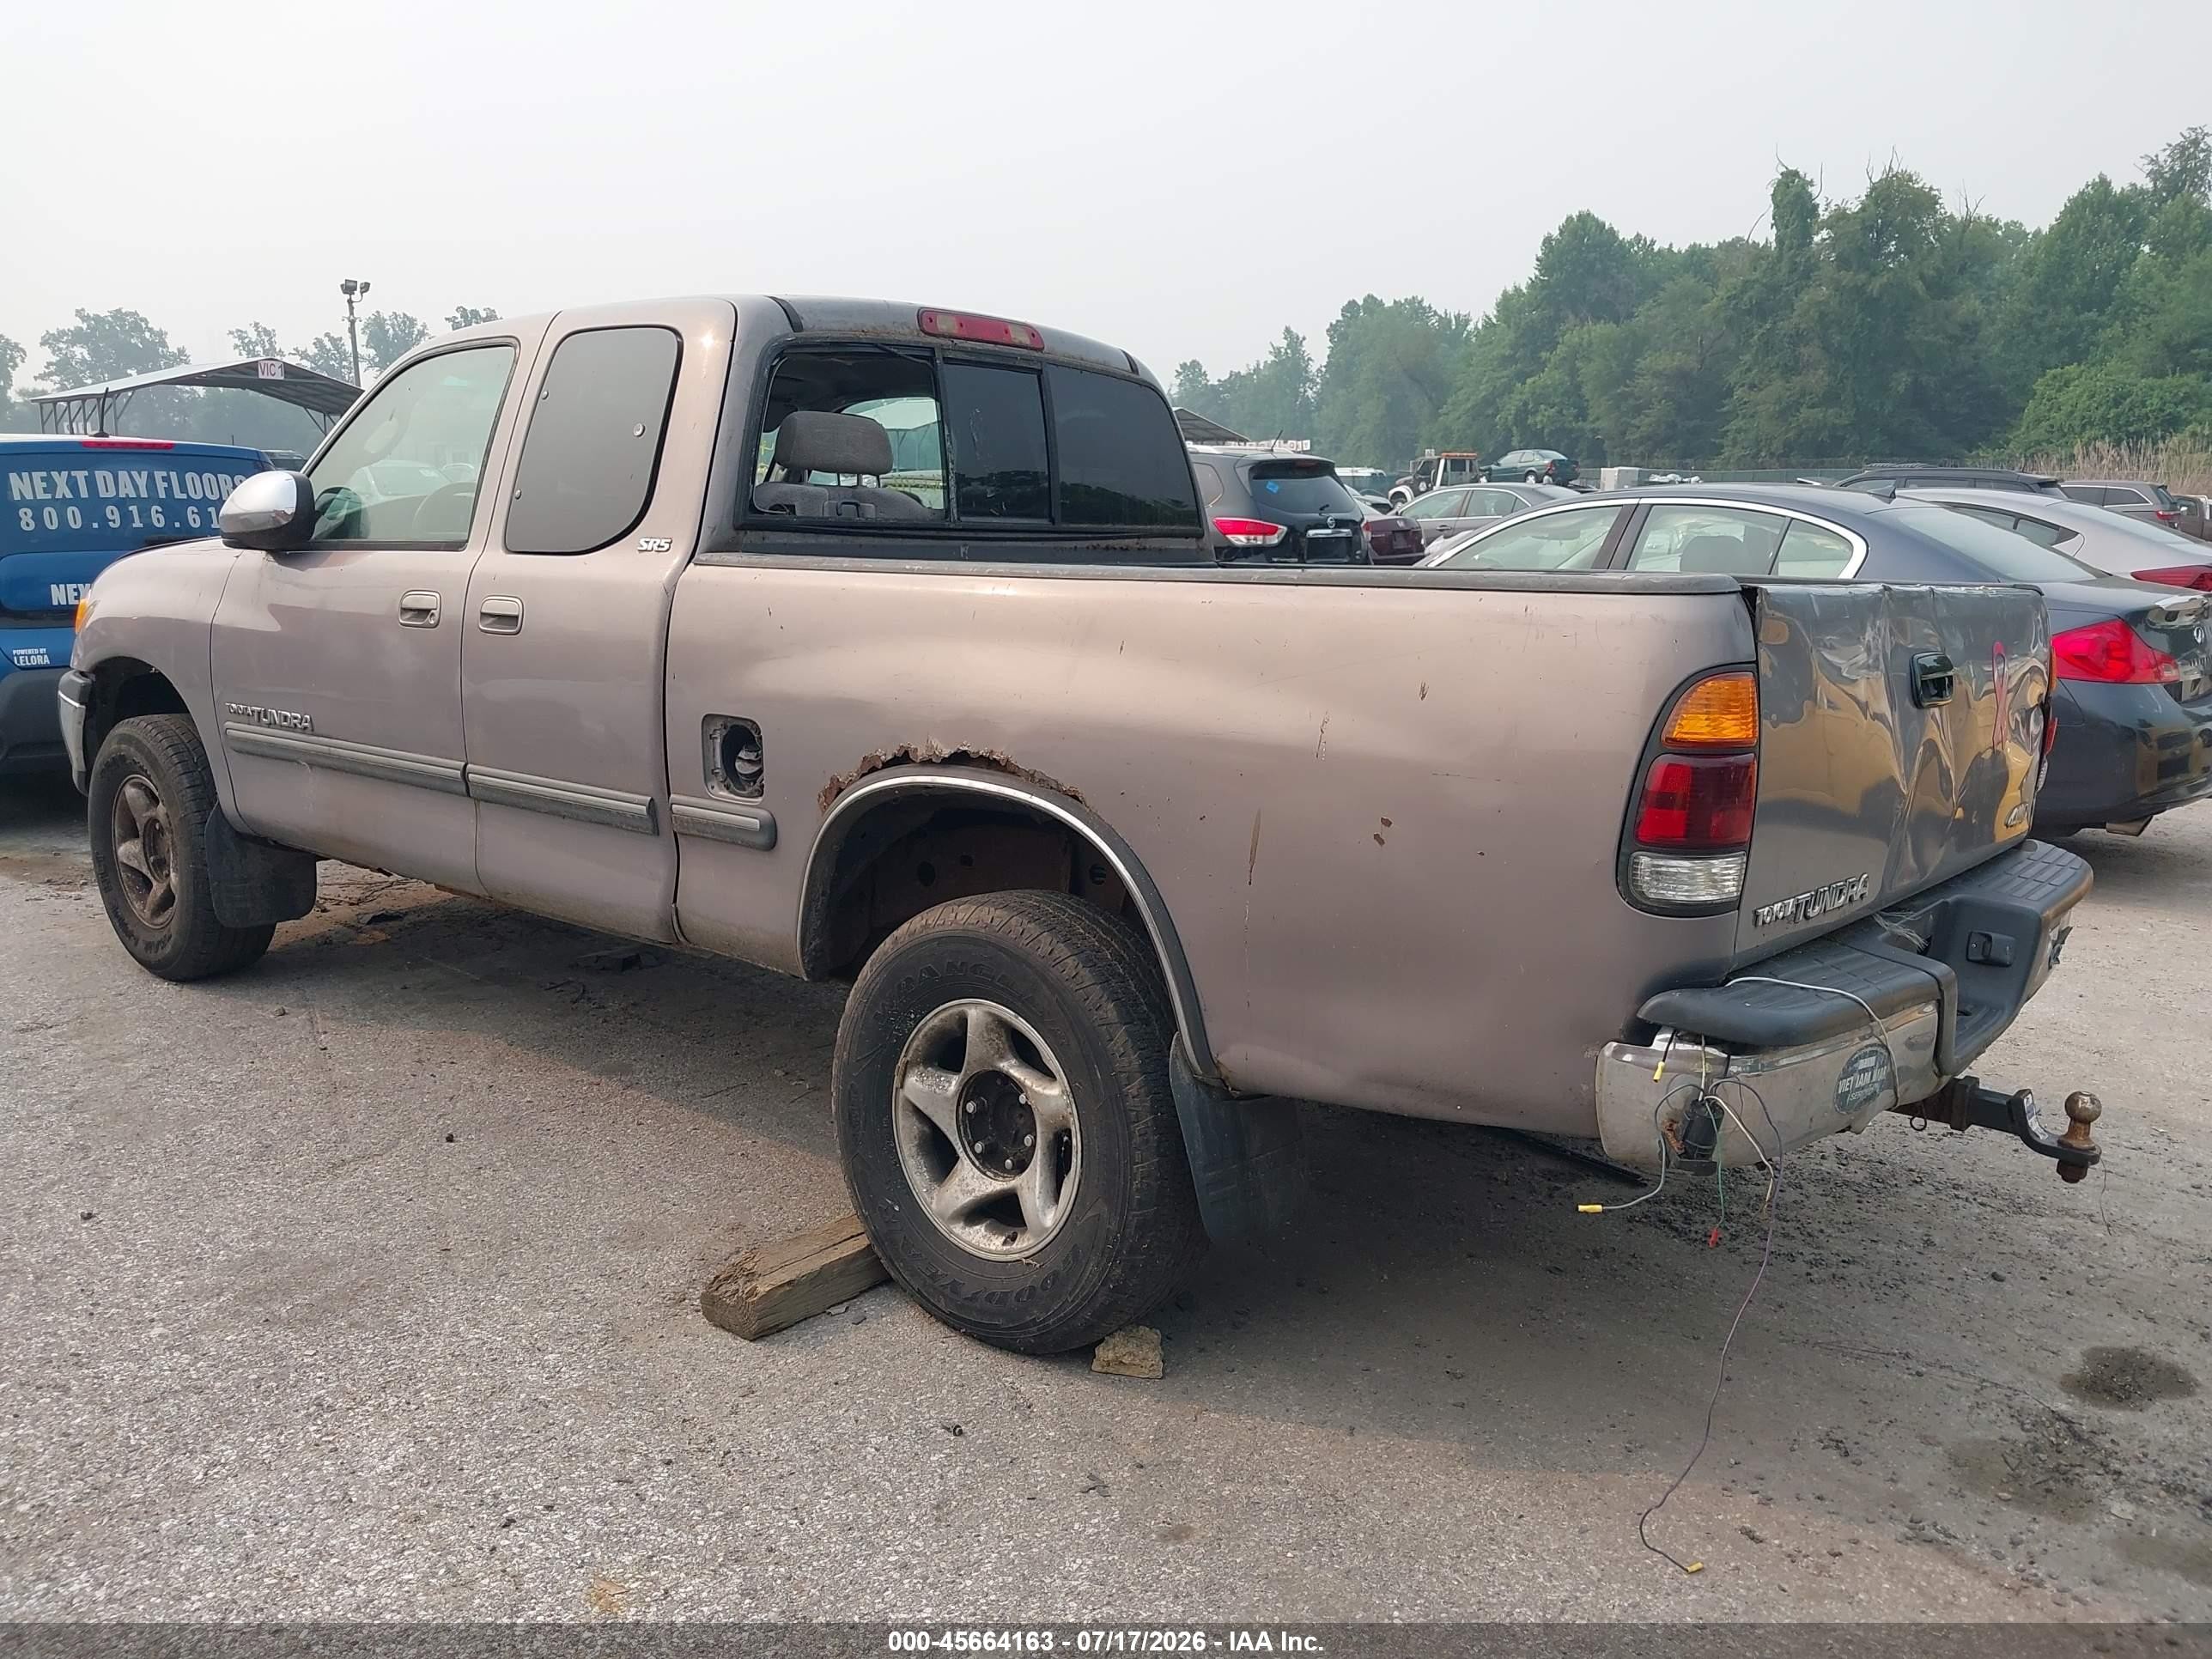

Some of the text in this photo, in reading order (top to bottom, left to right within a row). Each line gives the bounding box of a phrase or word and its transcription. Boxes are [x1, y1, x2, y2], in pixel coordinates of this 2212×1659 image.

[259, 362, 283, 376] VIC 1
[8, 470, 88, 501] NEXT
[94, 470, 149, 499] DAY
[637, 538, 672, 552] SR5
[14, 654, 51, 666] LELORA
[252, 707, 314, 731] TUNDRA
[1753, 873, 1869, 927] TOYOTA TUNDRA
